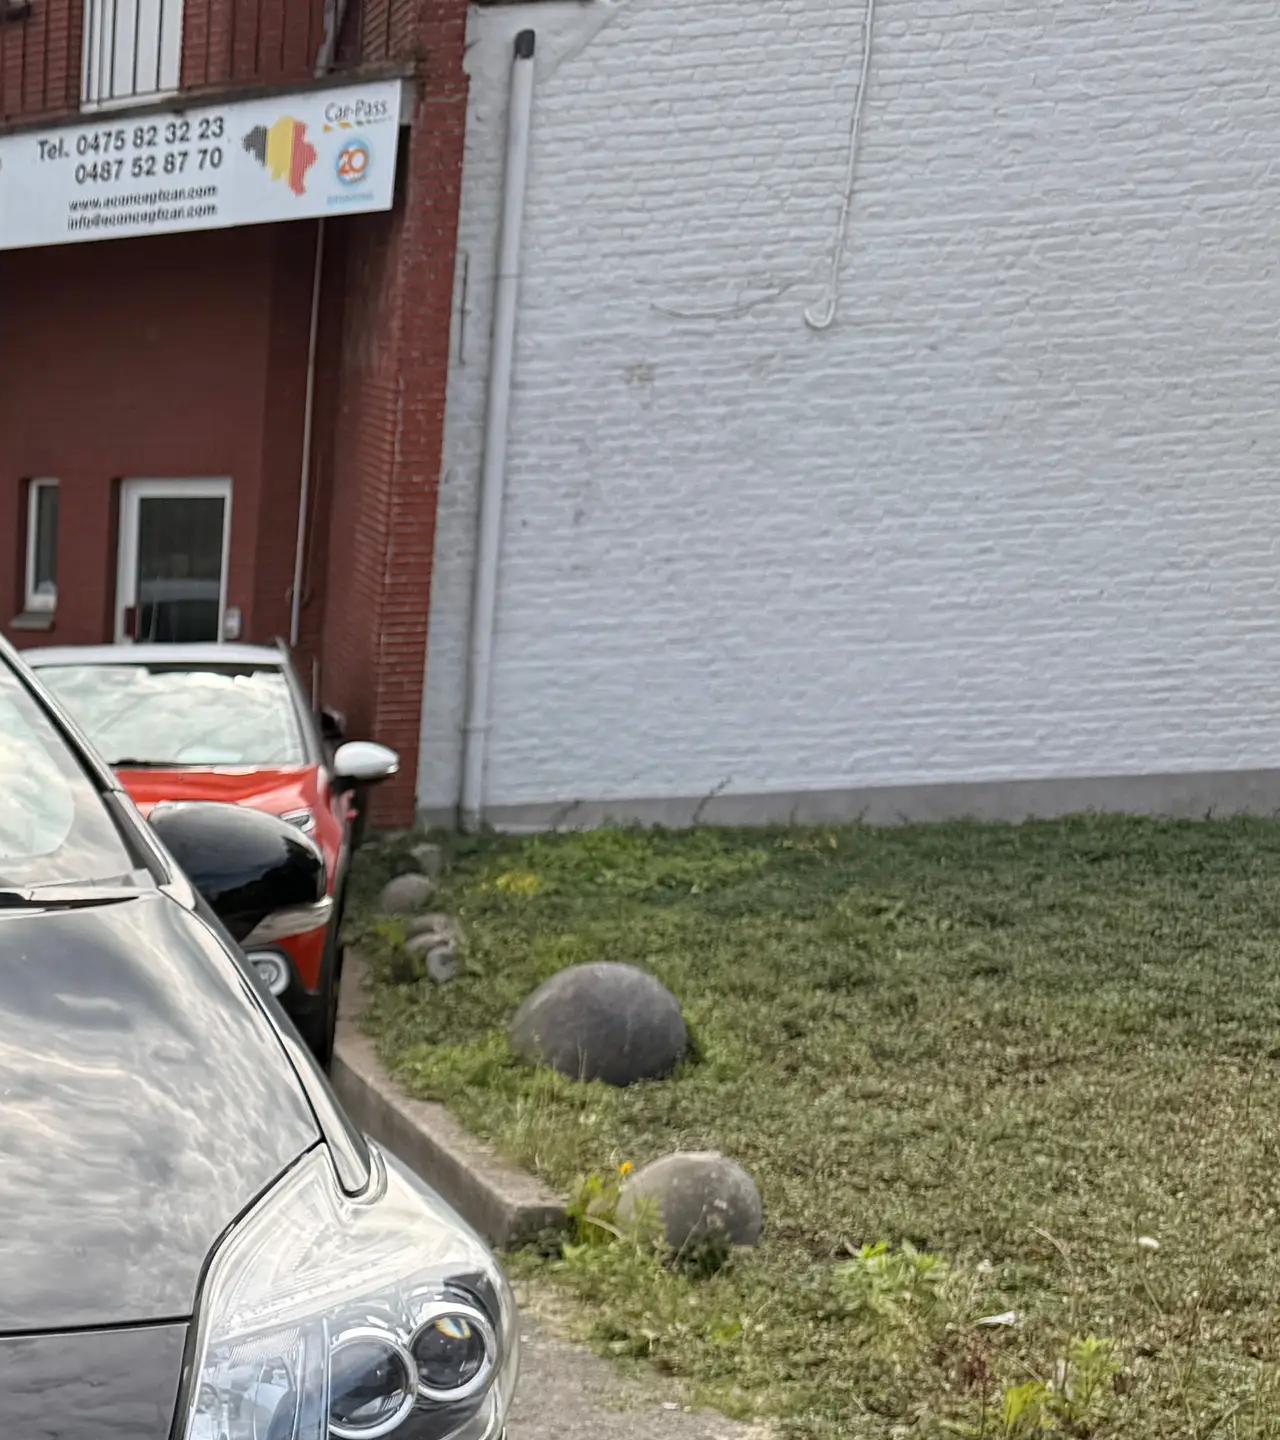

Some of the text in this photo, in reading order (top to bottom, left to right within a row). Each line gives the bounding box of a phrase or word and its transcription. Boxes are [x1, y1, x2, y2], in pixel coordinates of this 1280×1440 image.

[325, 99, 388, 122] Car-Pass
[37, 116, 225, 161] Tel. 0475 82 32 23
[74, 146, 223, 185] 0487 52 87 70
[69, 185, 217, 212] www.econceptcar.com
